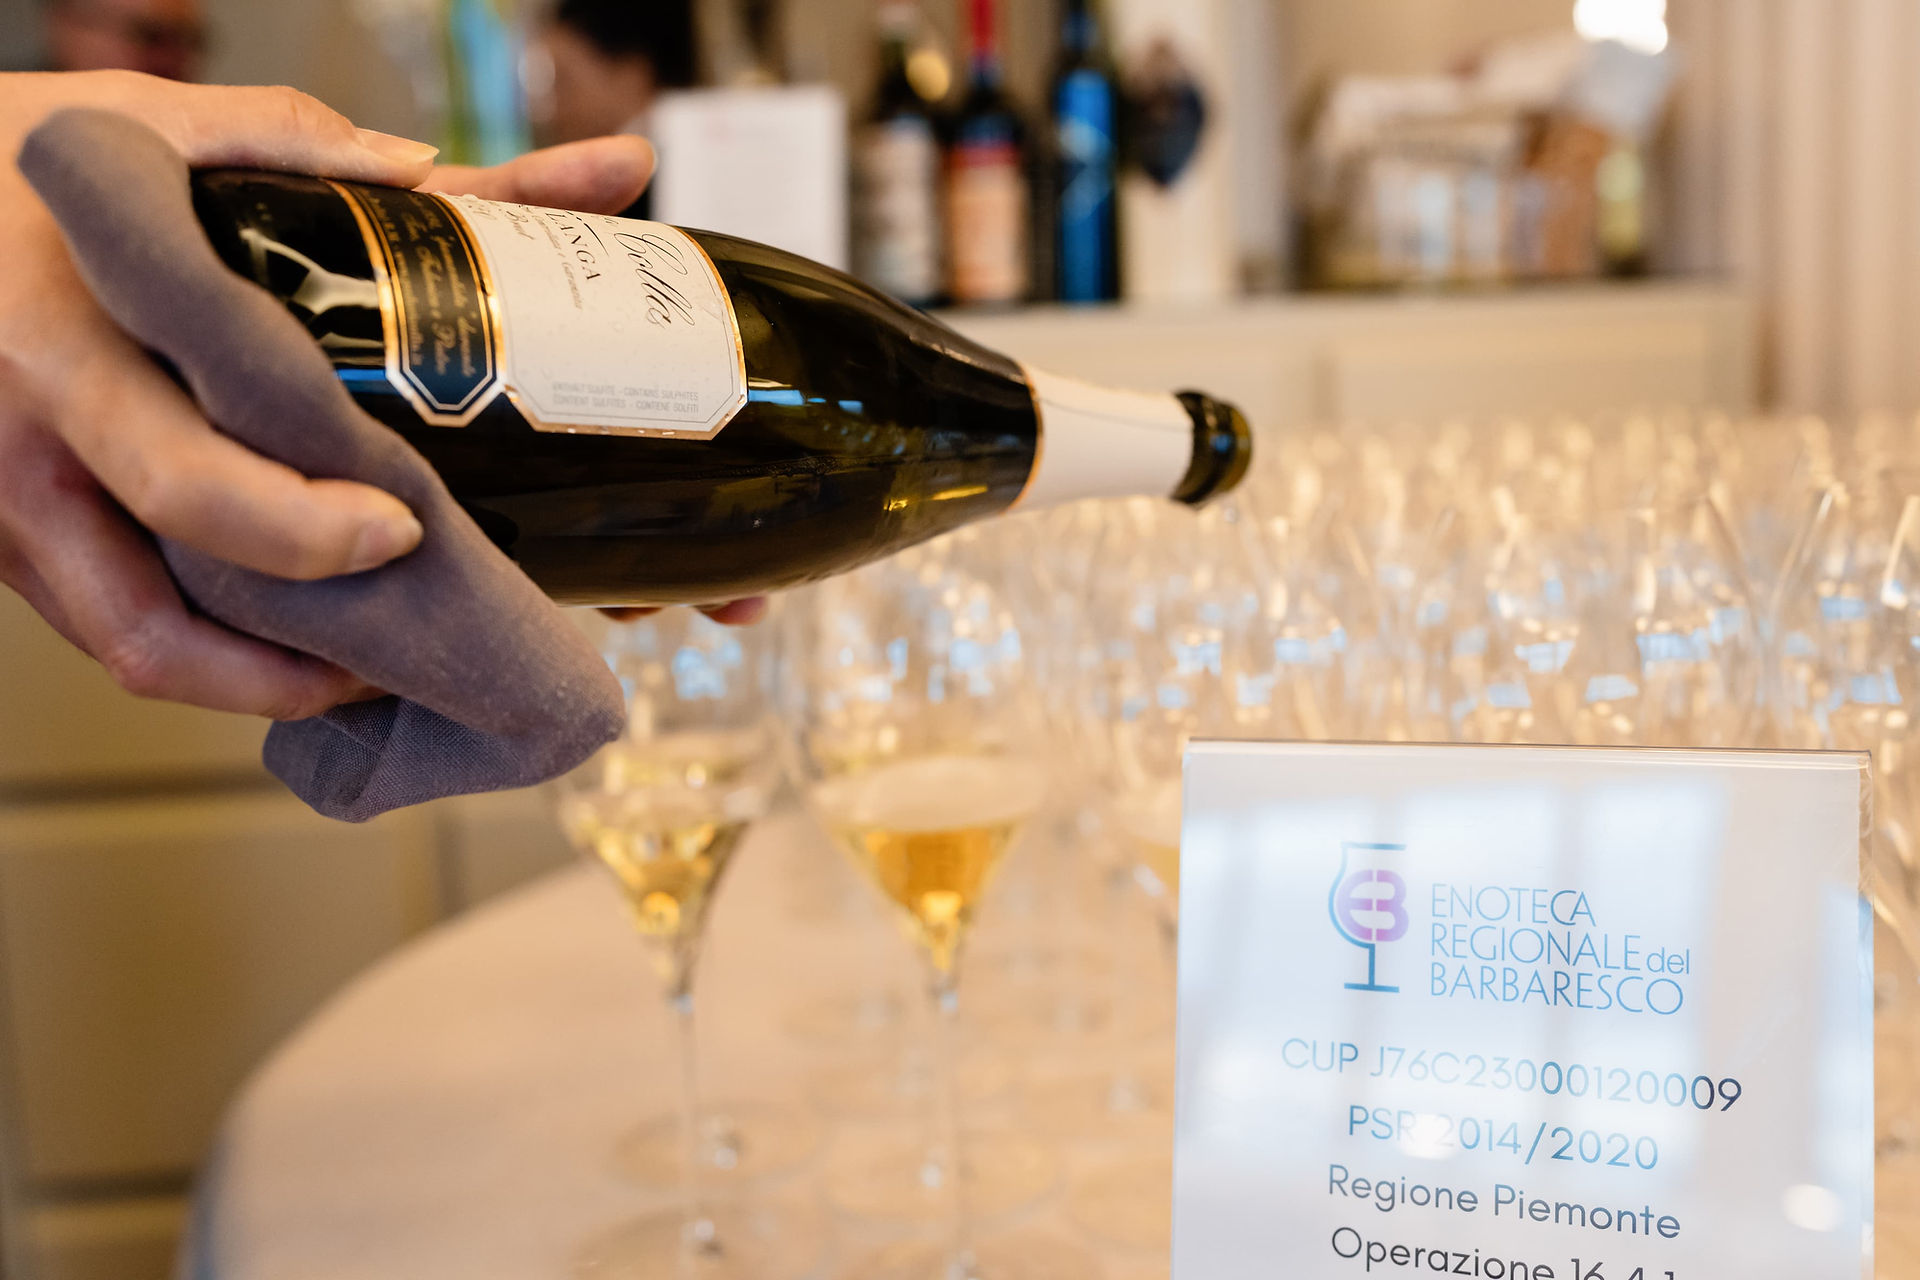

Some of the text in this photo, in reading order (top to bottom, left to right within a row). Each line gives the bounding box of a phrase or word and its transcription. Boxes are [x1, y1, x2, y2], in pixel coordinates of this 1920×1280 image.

[545, 212, 601, 280] LANGA
[661, 389, 699, 401] SULPHITES
[1431, 883, 1597, 927] ENOTECA
[1431, 922, 1690, 975] REGIONALE del
[1430, 961, 1684, 1015] BARBARESCO
[1281, 1037, 1742, 1112] CUP J76C23000120009
[1349, 1104, 1659, 1171] PSR 2014/2020
[1329, 1163, 1681, 1239] Regione Piemonte
[1331, 1226, 1555, 1280] Operazione
